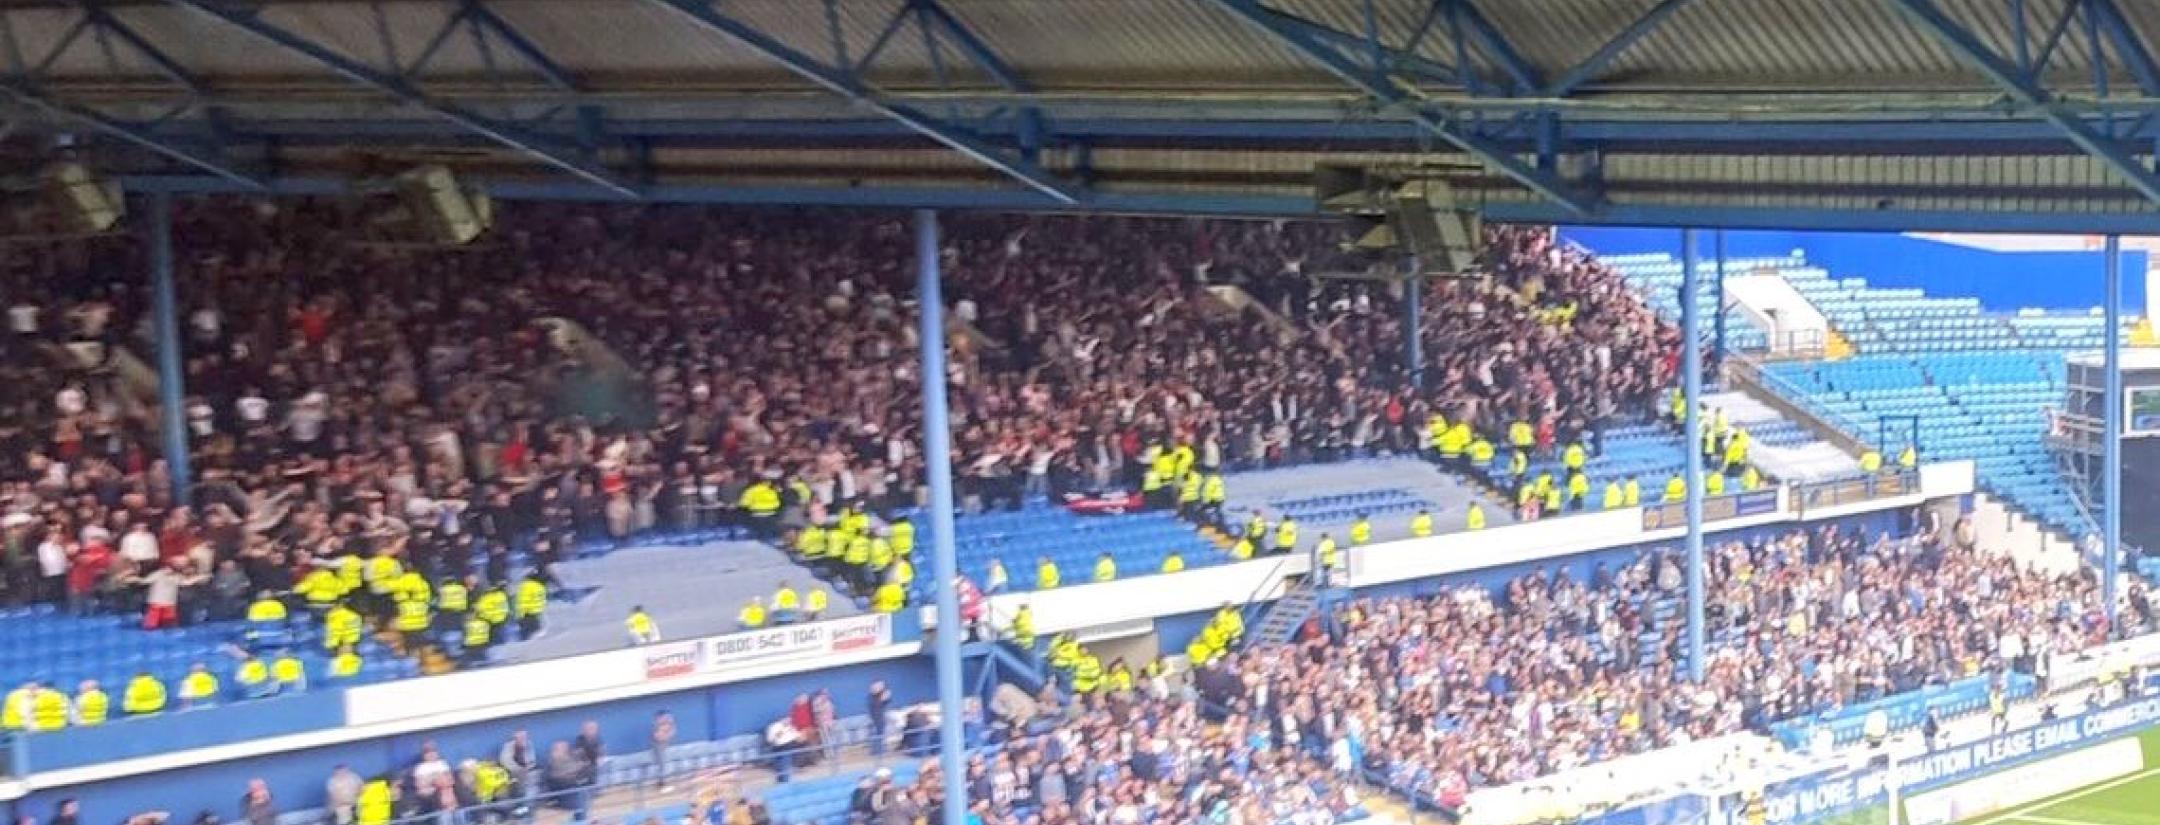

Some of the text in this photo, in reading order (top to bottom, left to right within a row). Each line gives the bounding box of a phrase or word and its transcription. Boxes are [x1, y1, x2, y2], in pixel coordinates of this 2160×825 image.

[1766, 794, 1796, 820] OR
[1973, 731, 2033, 768] PLEASE
[2035, 720, 2080, 752] EMAIL
